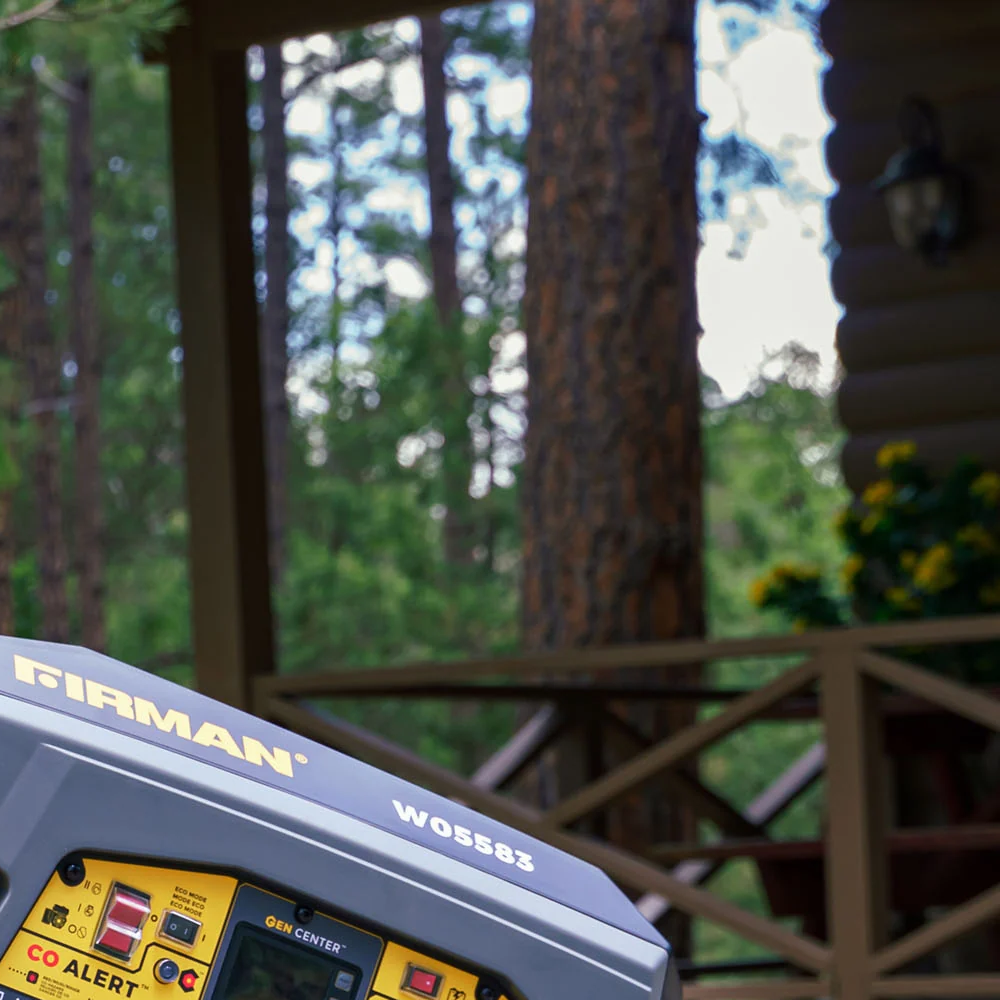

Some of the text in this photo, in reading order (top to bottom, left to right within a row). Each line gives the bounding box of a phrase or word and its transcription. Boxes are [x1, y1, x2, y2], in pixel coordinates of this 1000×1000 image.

[13, 654, 294, 778] FIRMAN
[392, 800, 535, 872] W05583
[169, 900, 202, 917] ECO MODE
[172, 893, 205, 910] MODE ECO
[174, 886, 207, 903] ECO MODE
[264, 914, 341, 954] GEN CENTER
[27, 944, 60, 967] CO
[62, 959, 139, 999] ALERT
